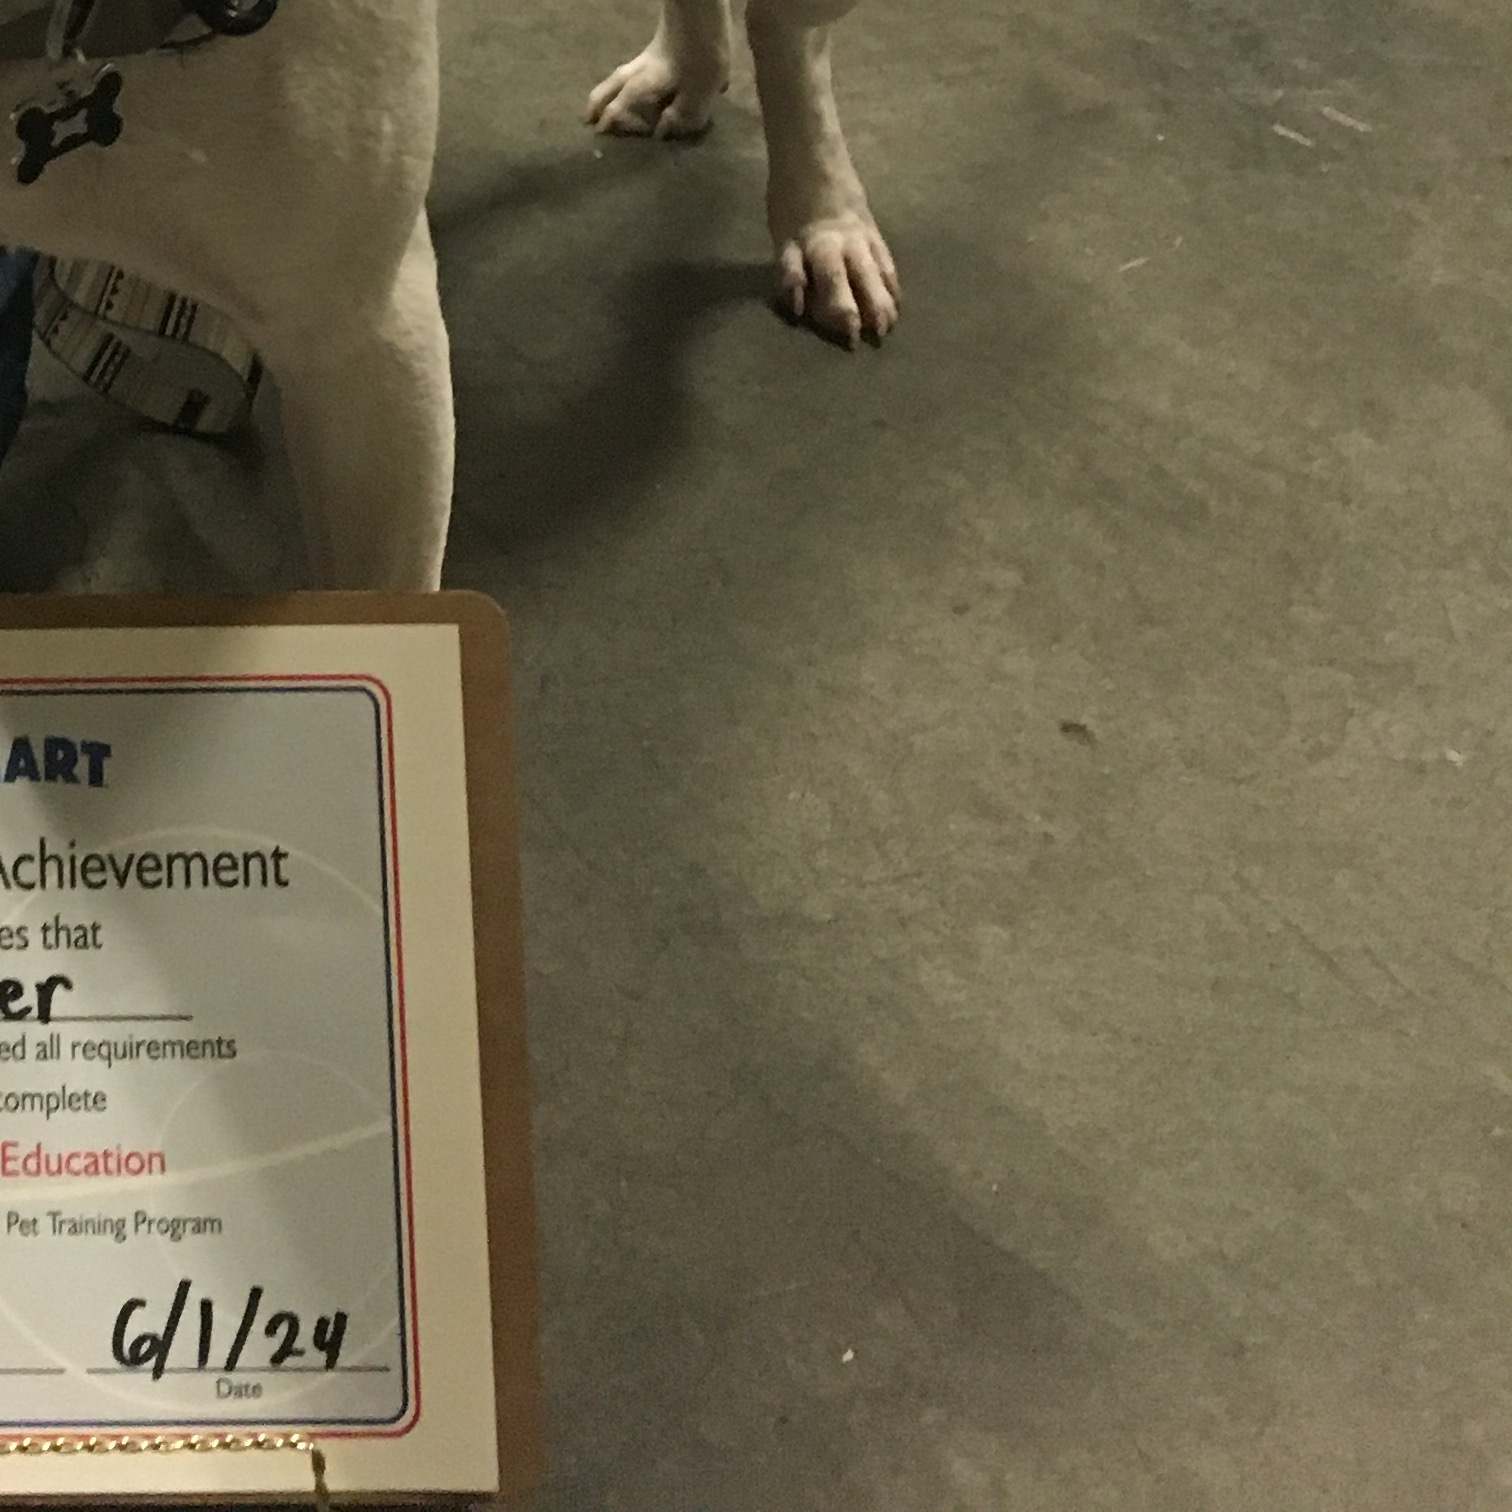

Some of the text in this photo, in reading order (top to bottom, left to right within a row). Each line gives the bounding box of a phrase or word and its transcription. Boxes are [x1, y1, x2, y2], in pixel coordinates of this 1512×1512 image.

[41, 914, 103, 950] that
[36, 1033, 61, 1061] all
[72, 1035, 238, 1068] requirements
[1, 1141, 166, 1177] Education
[7, 1211, 39, 1237] Pet
[47, 1211, 126, 1243] Training
[134, 1210, 222, 1242] Program
[112, 1279, 349, 1381] 6/1/24
[215, 1377, 263, 1400] Date
